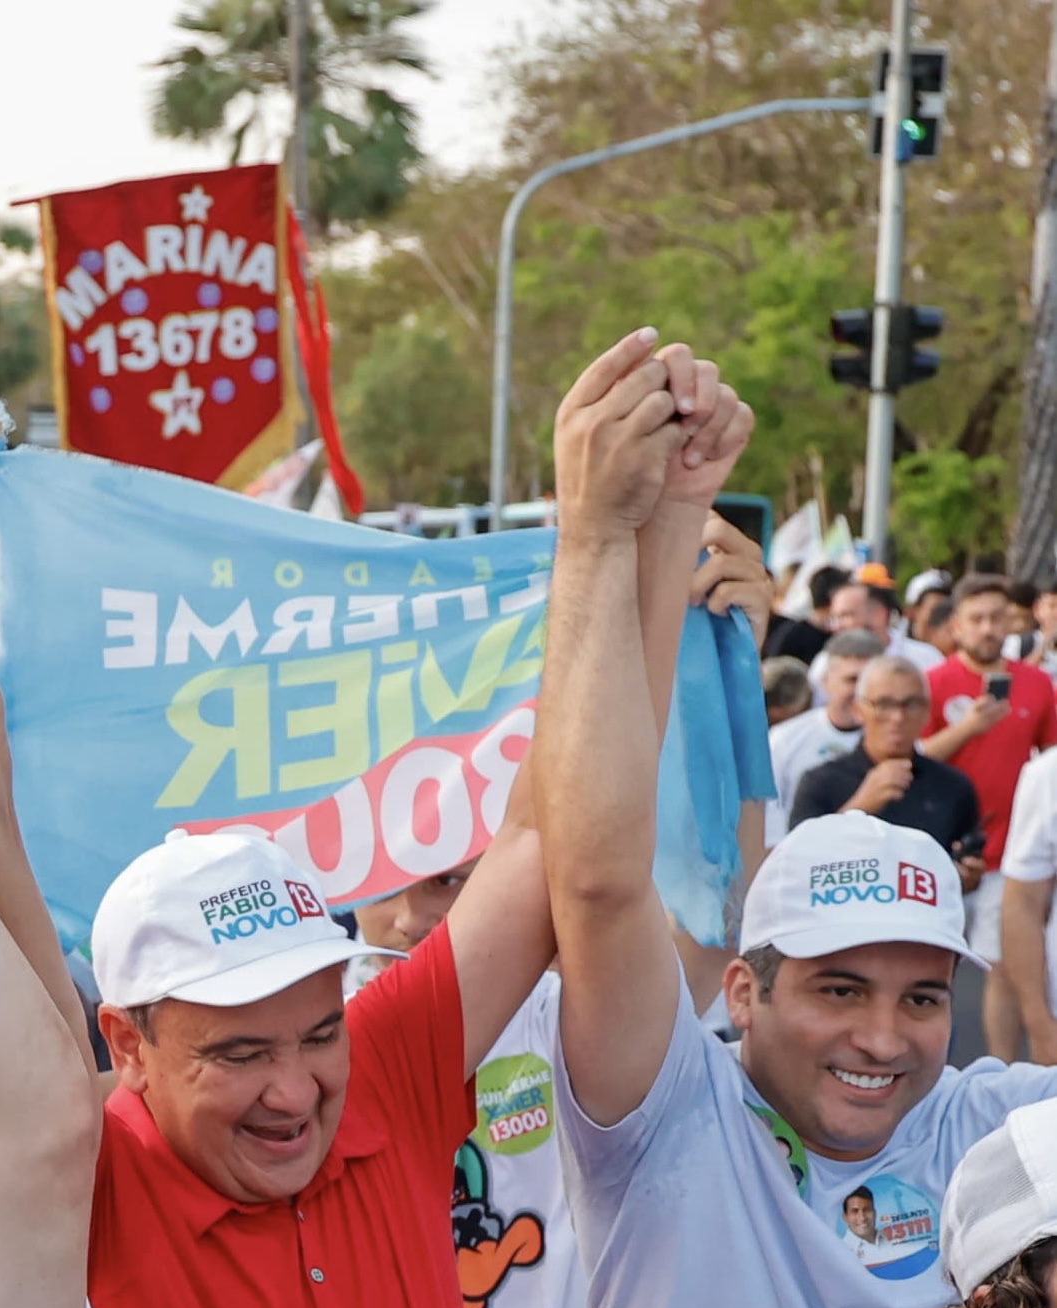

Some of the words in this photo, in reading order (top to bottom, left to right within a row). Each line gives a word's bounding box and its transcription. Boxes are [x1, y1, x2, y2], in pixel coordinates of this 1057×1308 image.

[56, 224, 277, 332] MARINA
[85, 306, 257, 376] 13678
[809, 859, 880, 875] PREFEITO
[810, 869, 880, 889] FABIO
[900, 866, 934, 900] 13
[199, 880, 272, 911] PREFEITO
[203, 892, 277, 925] FABIO
[288, 883, 321, 915] 13
[810, 885, 896, 907] NOVO
[211, 906, 298, 945] NOVO
[489, 1107, 548, 1143] 13000
